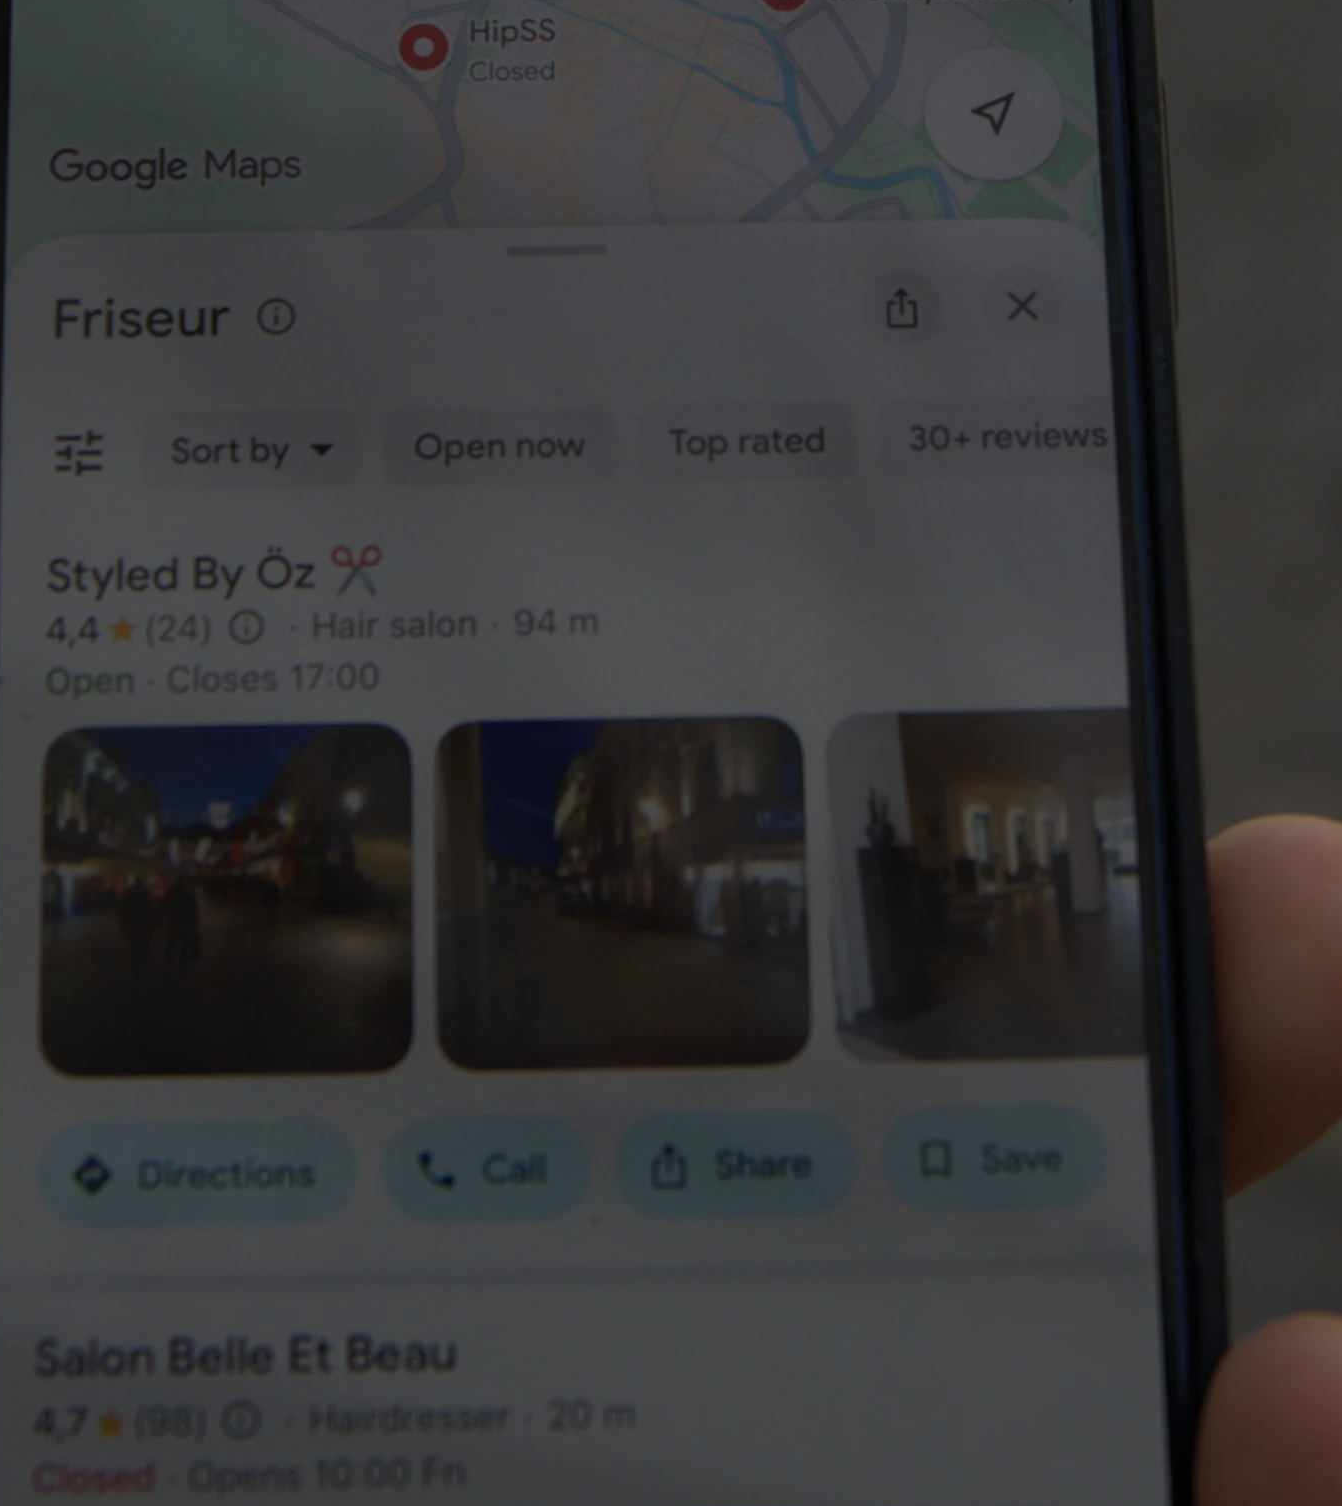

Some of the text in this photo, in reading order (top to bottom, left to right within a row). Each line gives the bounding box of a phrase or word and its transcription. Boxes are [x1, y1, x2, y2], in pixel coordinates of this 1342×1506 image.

[470, 18, 556, 48] HipSS
[469, 60, 556, 82] Closed
[48, 147, 301, 191] Google Maps
[54, 297, 230, 339] Friseur
[170, 436, 290, 470] Sort by
[414, 432, 586, 467] Open now
[668, 426, 826, 463] Top rated
[909, 421, 1107, 452] 30+ reviews
[47, 546, 316, 602] Styled By Öz
[46, 607, 600, 649] 4,4 (24) Hair salon 94 m
[44, 660, 381, 703] Open Closes 17:00
[137, 1157, 317, 1191] Directions
[480, 1152, 549, 1186] Call
[714, 1146, 814, 1181] Share
[980, 1141, 1065, 1175] Save
[34, 1331, 457, 1380] Salon Belle Et Beau
[32, 1404, 89, 1442] 4,7
[308, 1401, 511, 1435] Hairdresser
[548, 1395, 593, 1432] 20
[602, 1401, 638, 1427] m
[31, 1461, 157, 1498] Closed
[185, 1458, 303, 1499] Opens
